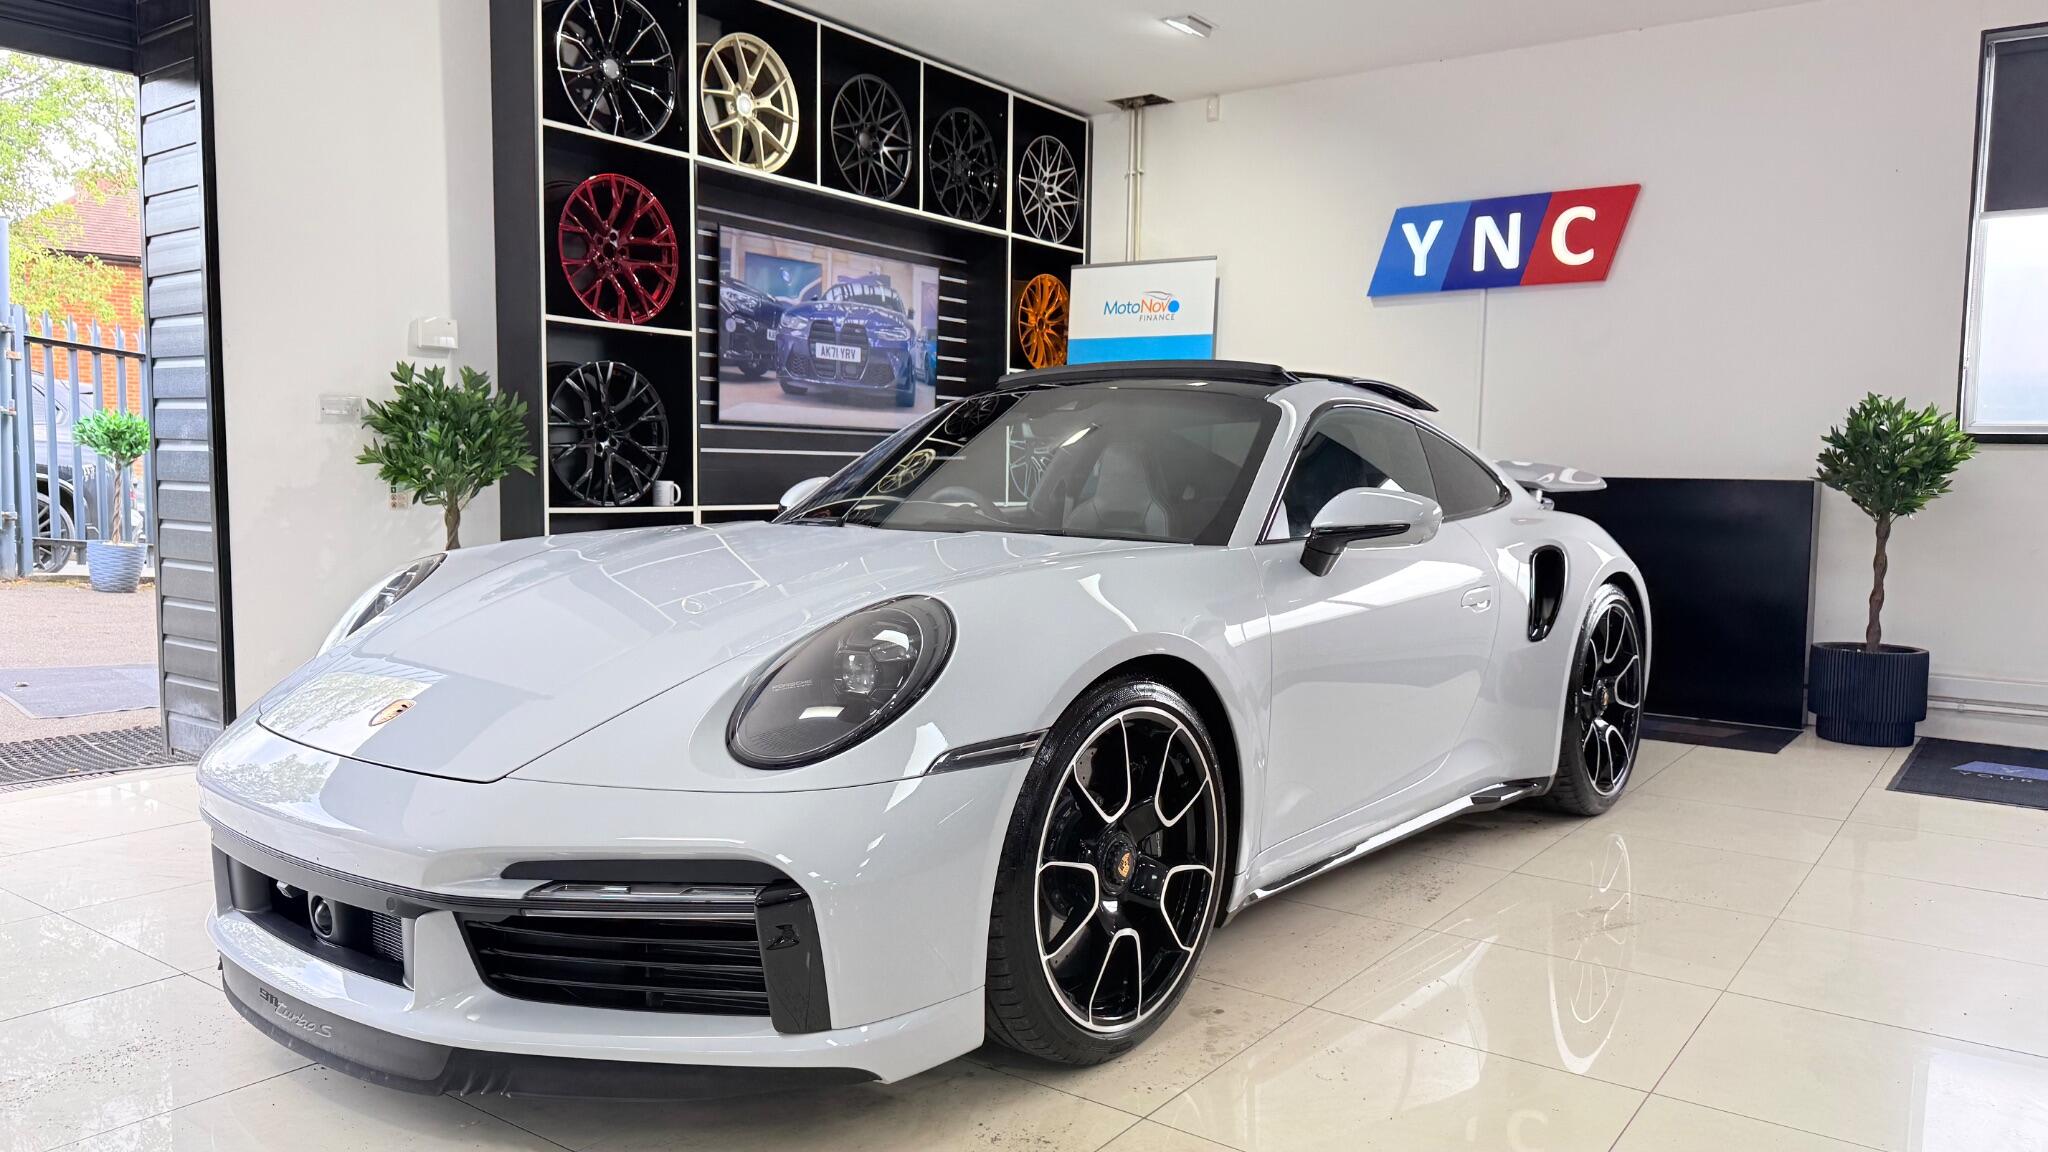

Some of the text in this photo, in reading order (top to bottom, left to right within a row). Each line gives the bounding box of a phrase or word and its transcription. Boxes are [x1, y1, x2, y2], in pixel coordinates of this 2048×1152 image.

[1401, 205, 1596, 277] YNC
[1139, 313, 1175, 322] FINANCE
[821, 345, 856, 360] AK71 YRV
[275, 1002, 317, 1032] Turbo
[315, 1025, 333, 1038] S
